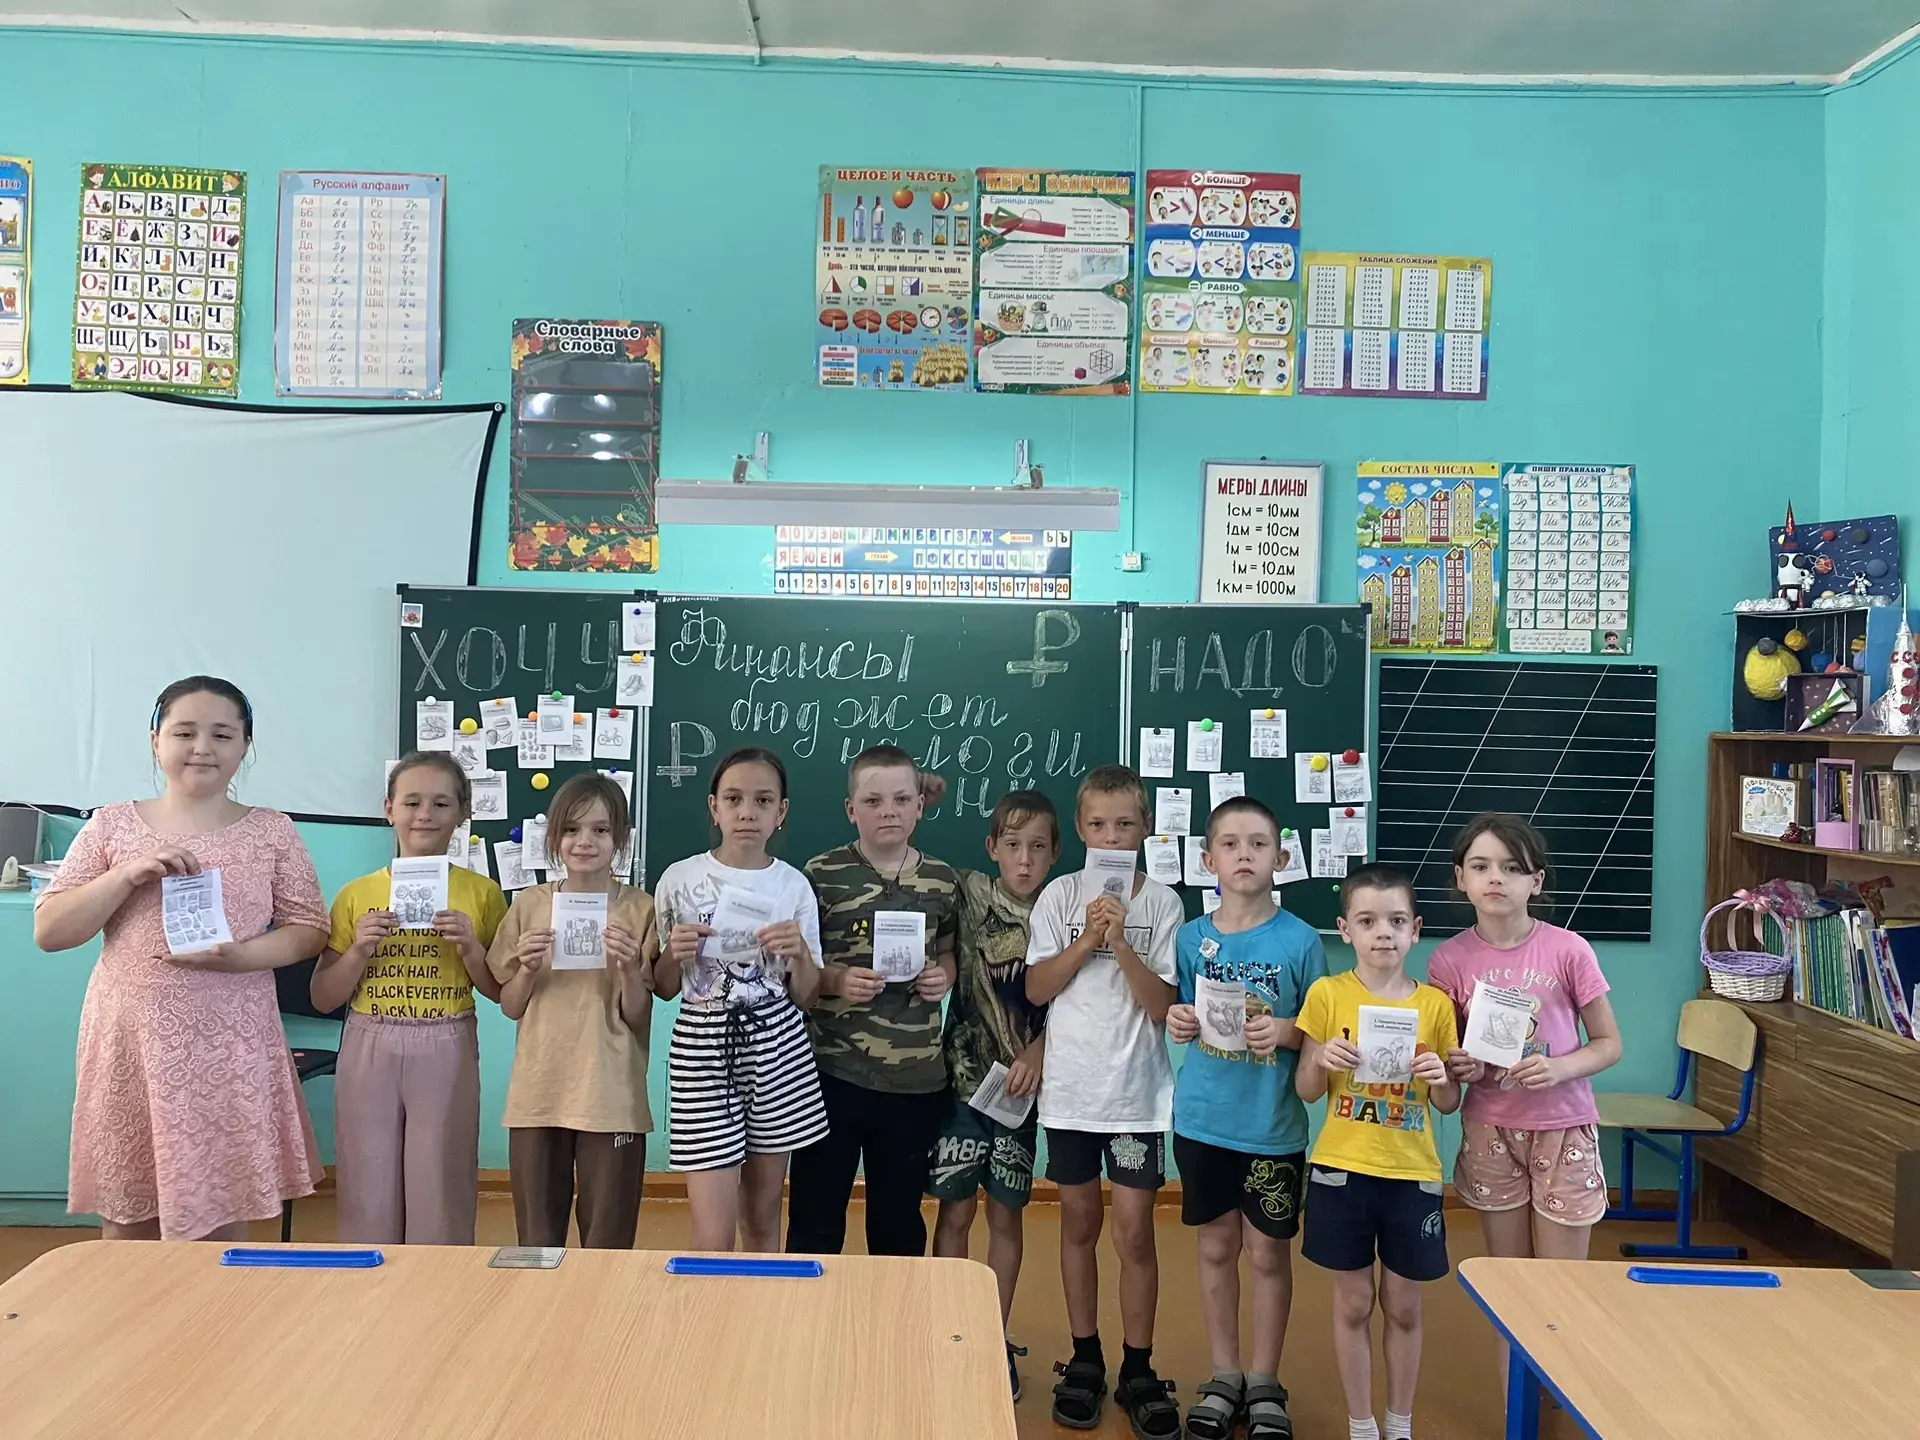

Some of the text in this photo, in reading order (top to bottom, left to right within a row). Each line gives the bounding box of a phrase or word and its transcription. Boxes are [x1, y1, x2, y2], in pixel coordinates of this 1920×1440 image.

[108, 171, 218, 192] АЛФАВИТ
[837, 171, 957, 183] ЦЕЛОЕ И ЧАСТЬ
[986, 173, 1130, 195] МЕРЫ ВЕЛИЧИН
[1207, 176, 1246, 184] БОЛЬШЕ
[313, 179, 410, 192] Русский алфавит
[87, 193, 228, 216] А Б В Г Д
[990, 196, 1027, 204] Единицы
[86, 219, 225, 242] Е Ё Ж З И
[84, 244, 225, 268] Й К Л М Н
[1043, 245, 1079, 253] Единицы
[82, 274, 224, 295] О П Р С Т
[989, 292, 1024, 300] Единицы
[81, 301, 221, 323] У Ф Х Ц Ч
[536, 322, 639, 341] Словарные
[78, 329, 220, 351] Ш Щ Ъ Ы Ь
[561, 341, 615, 353] слова
[1037, 340, 1073, 348] Единицы
[110, 358, 189, 376] Э Ю Я
[1381, 465, 1475, 475] СОСТАВ ЧИСЛА
[1218, 478, 1307, 496] МЕРЫ ДЛИНЫ
[1228, 502, 1251, 516] 1см
[1268, 504, 1299, 517] 10мм
[888, 529, 1067, 543] М Н Б В Г Ж Ь Ъ
[1227, 522, 1249, 535] 1дм
[1267, 523, 1299, 537] 10см
[1226, 541, 1239, 554] 1м
[1258, 542, 1299, 556] 100см
[1233, 560, 1247, 574] 1м
[1262, 561, 1295, 575] 10дм
[780, 579, 1068, 593] 0 1 2 3 4 5 6 7 8 9 10 11 12 13 14 15 16 17 18 19 20
[1217, 579, 1242, 593] 1км
[1257, 580, 1295, 595] 1000м
[670, 606, 915, 683] Финансы
[409, 620, 620, 694] ХОЧУ
[1150, 624, 1337, 698] НАДО
[730, 677, 1008, 758] бюджет
[370, 944, 441, 958] LACK LIPS.
[367, 965, 441, 979] BLACK HAIR.
[367, 986, 405, 998] BLACK
[1336, 1094, 1424, 1131] BABY
